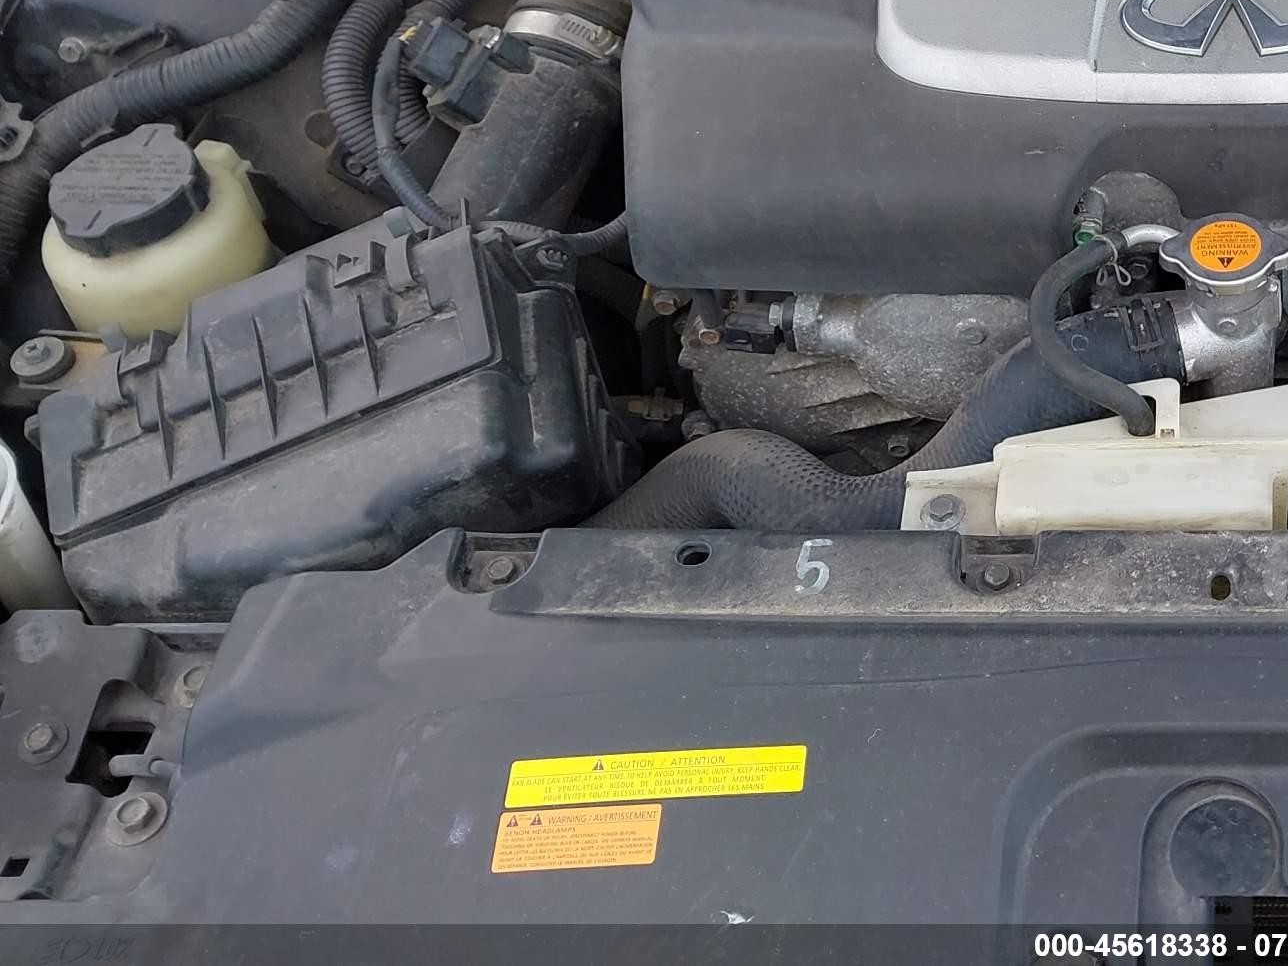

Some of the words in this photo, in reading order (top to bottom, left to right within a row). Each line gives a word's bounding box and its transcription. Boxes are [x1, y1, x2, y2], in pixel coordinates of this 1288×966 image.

[1201, 249, 1249, 257] WARNING
[795, 538, 833, 595] 5
[610, 759, 655, 770] CAUTION
[671, 755, 726, 766] ATTENTION
[548, 814, 588, 825] WARNING
[593, 811, 657, 822] AVERTISSEMENT
